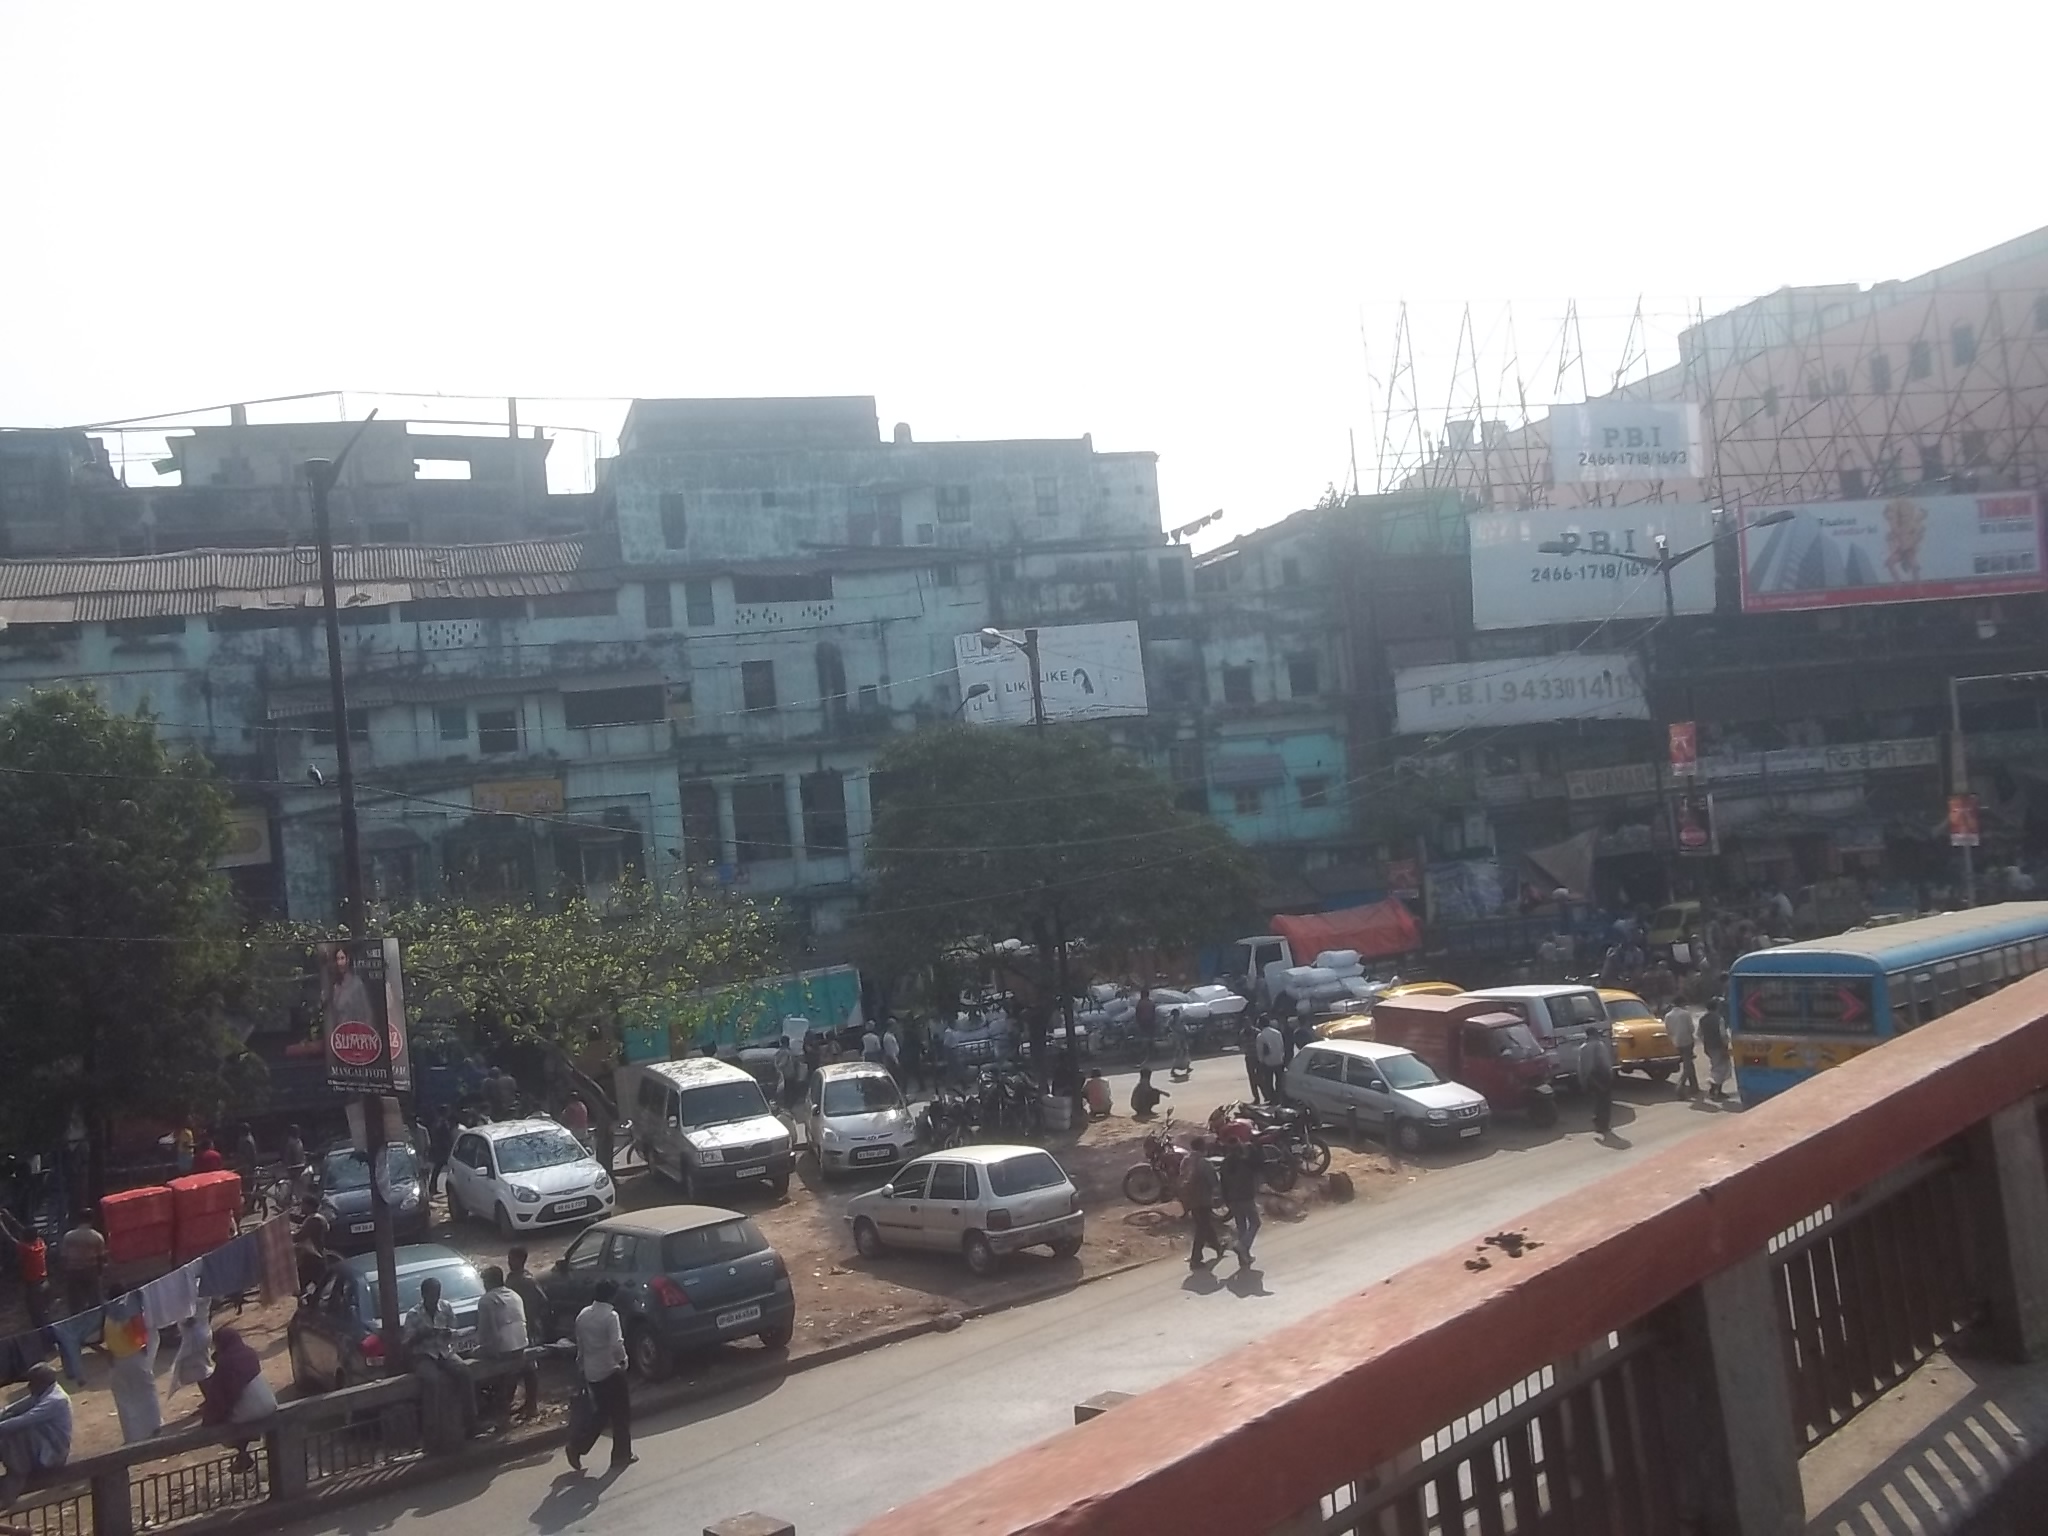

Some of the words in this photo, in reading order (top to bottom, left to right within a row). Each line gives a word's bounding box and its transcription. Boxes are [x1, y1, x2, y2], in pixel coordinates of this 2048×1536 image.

[1603, 427, 1662, 448] P.B.I
[1005, 681, 1031, 693] LIK
[335, 1033, 378, 1050] SUMAN
